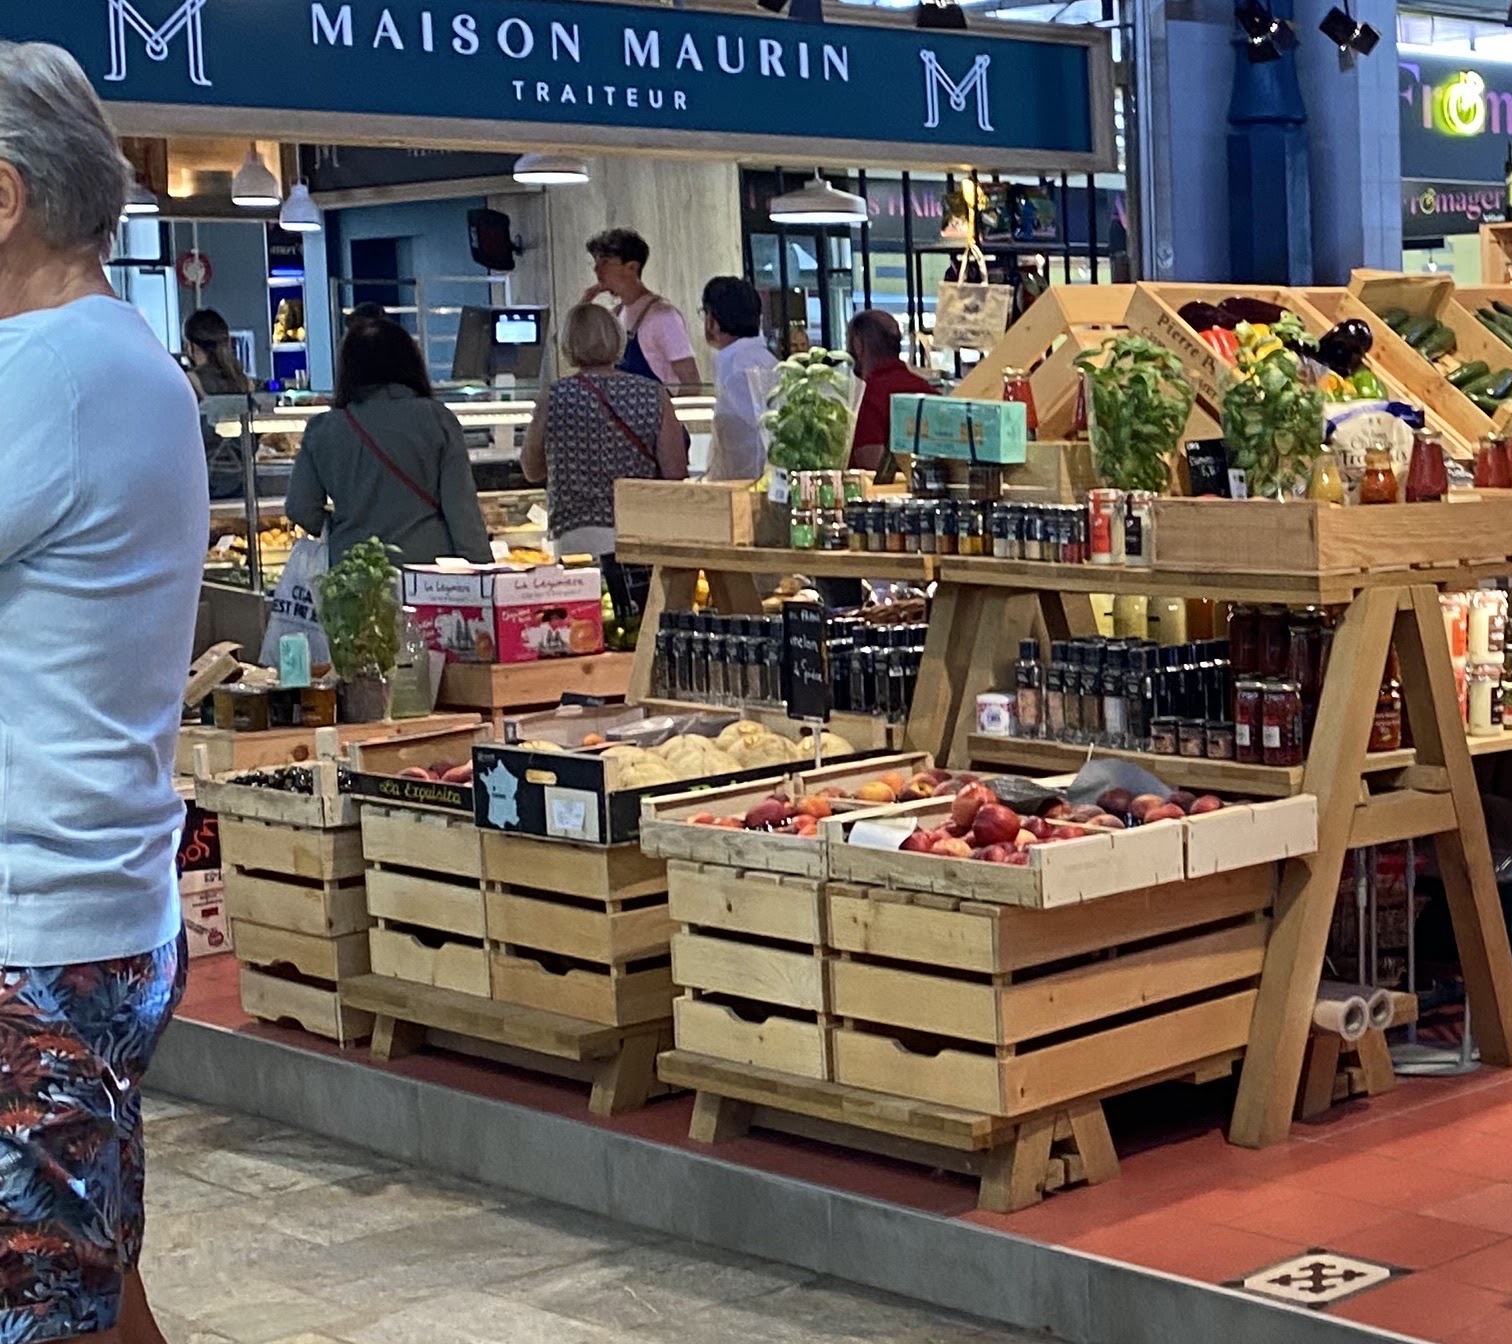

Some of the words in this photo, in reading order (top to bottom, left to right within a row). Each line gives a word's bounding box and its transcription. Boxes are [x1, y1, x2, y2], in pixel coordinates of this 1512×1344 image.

[310, 2, 581, 64] MAISON
[624, 28, 850, 83] MAURIN
[512, 79, 688, 111] TRAITEUR
